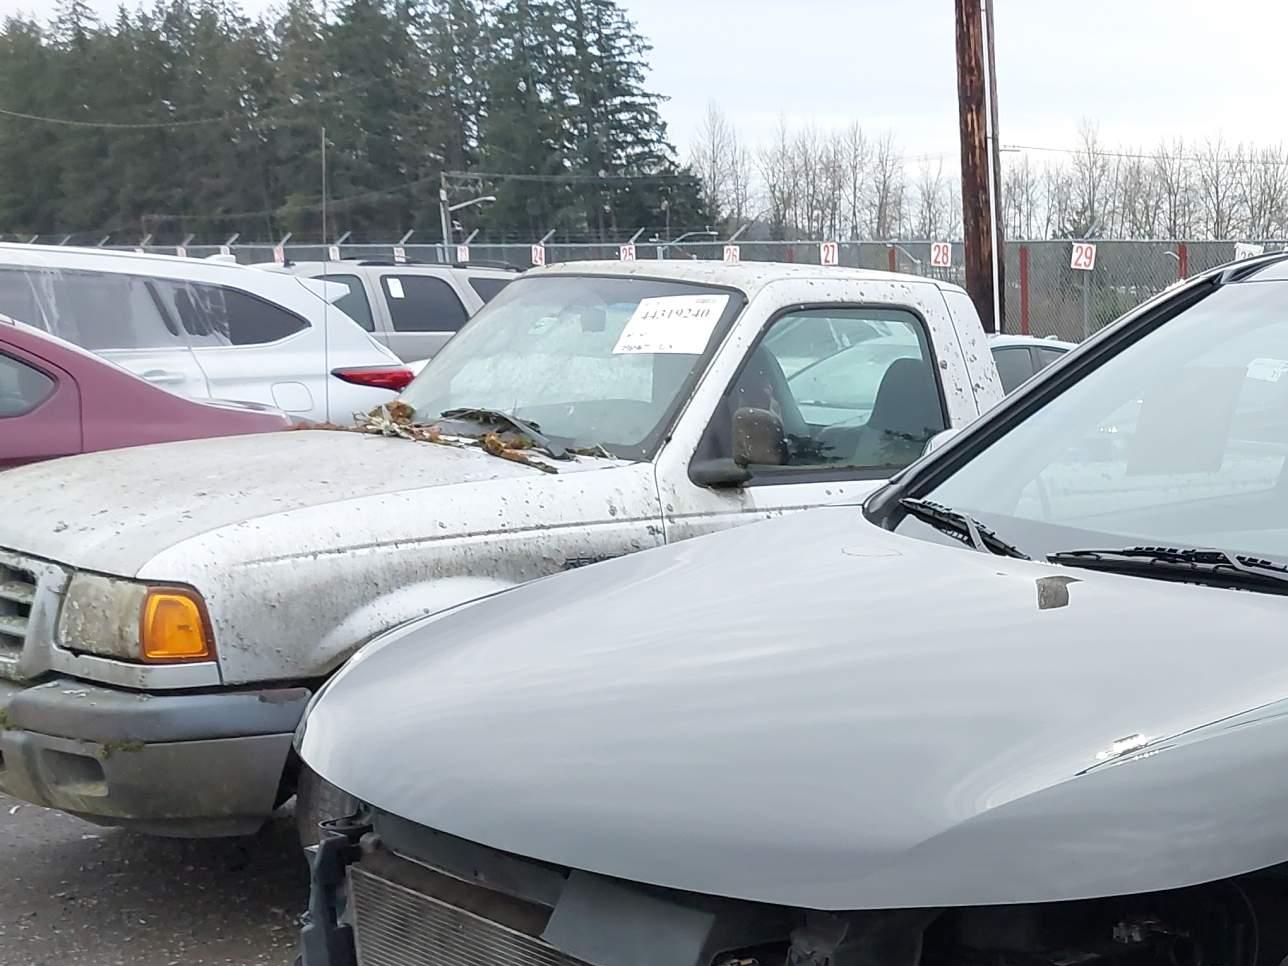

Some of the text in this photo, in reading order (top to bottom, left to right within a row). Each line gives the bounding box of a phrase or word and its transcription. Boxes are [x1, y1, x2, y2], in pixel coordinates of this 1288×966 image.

[533, 247, 543, 264] 24
[621, 247, 634, 260] 25
[823, 244, 835, 263] 27
[933, 244, 949, 265] 28
[1073, 245, 1093, 268] 29
